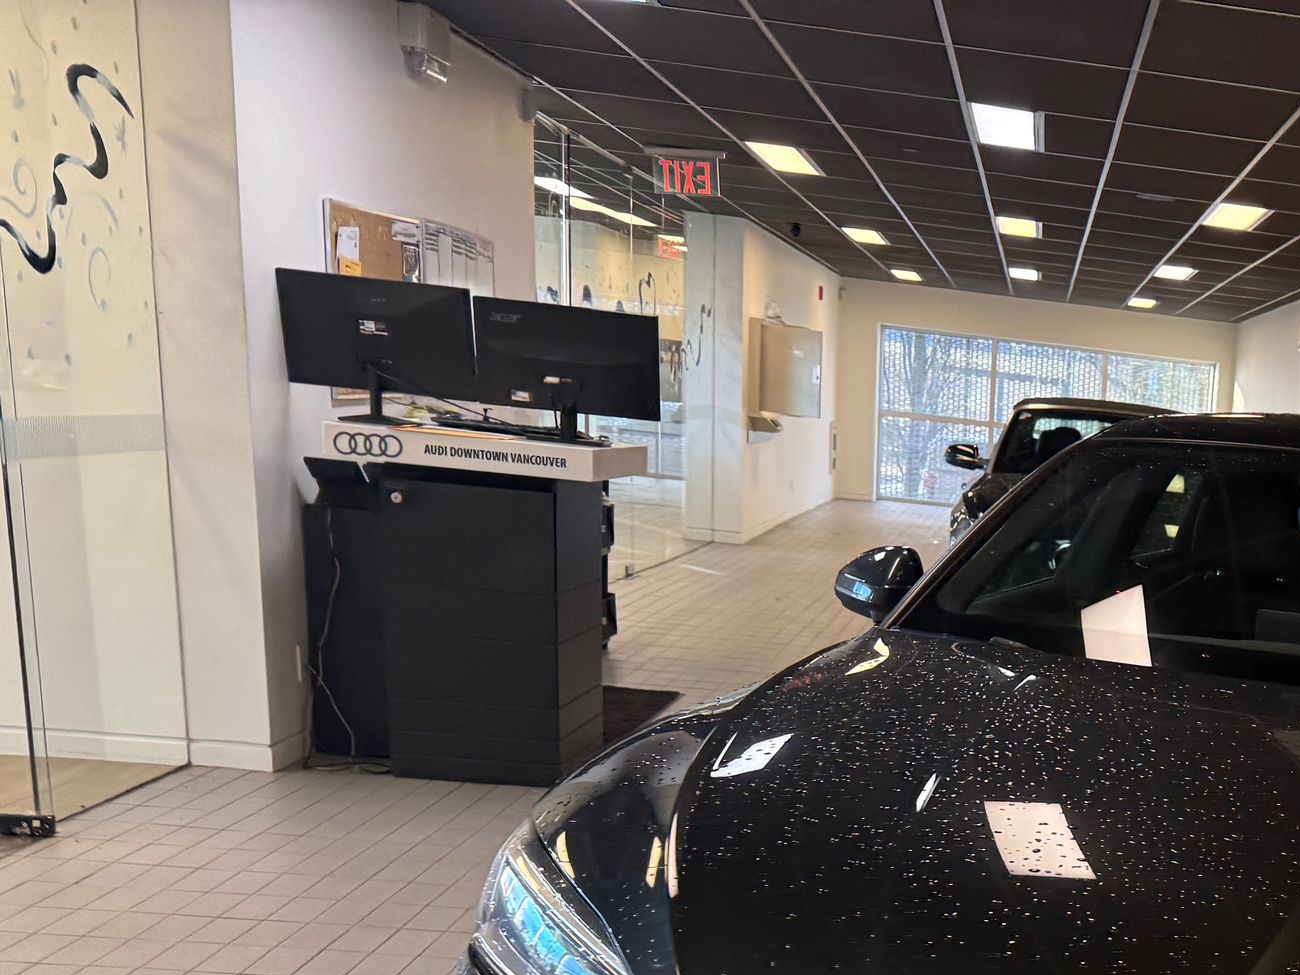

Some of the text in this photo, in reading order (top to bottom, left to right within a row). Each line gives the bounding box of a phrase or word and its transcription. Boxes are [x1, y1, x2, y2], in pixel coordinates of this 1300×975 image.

[488, 312, 521, 323] acer
[424, 443, 567, 469] AUDI DOWNTOWN VANCOUVER
